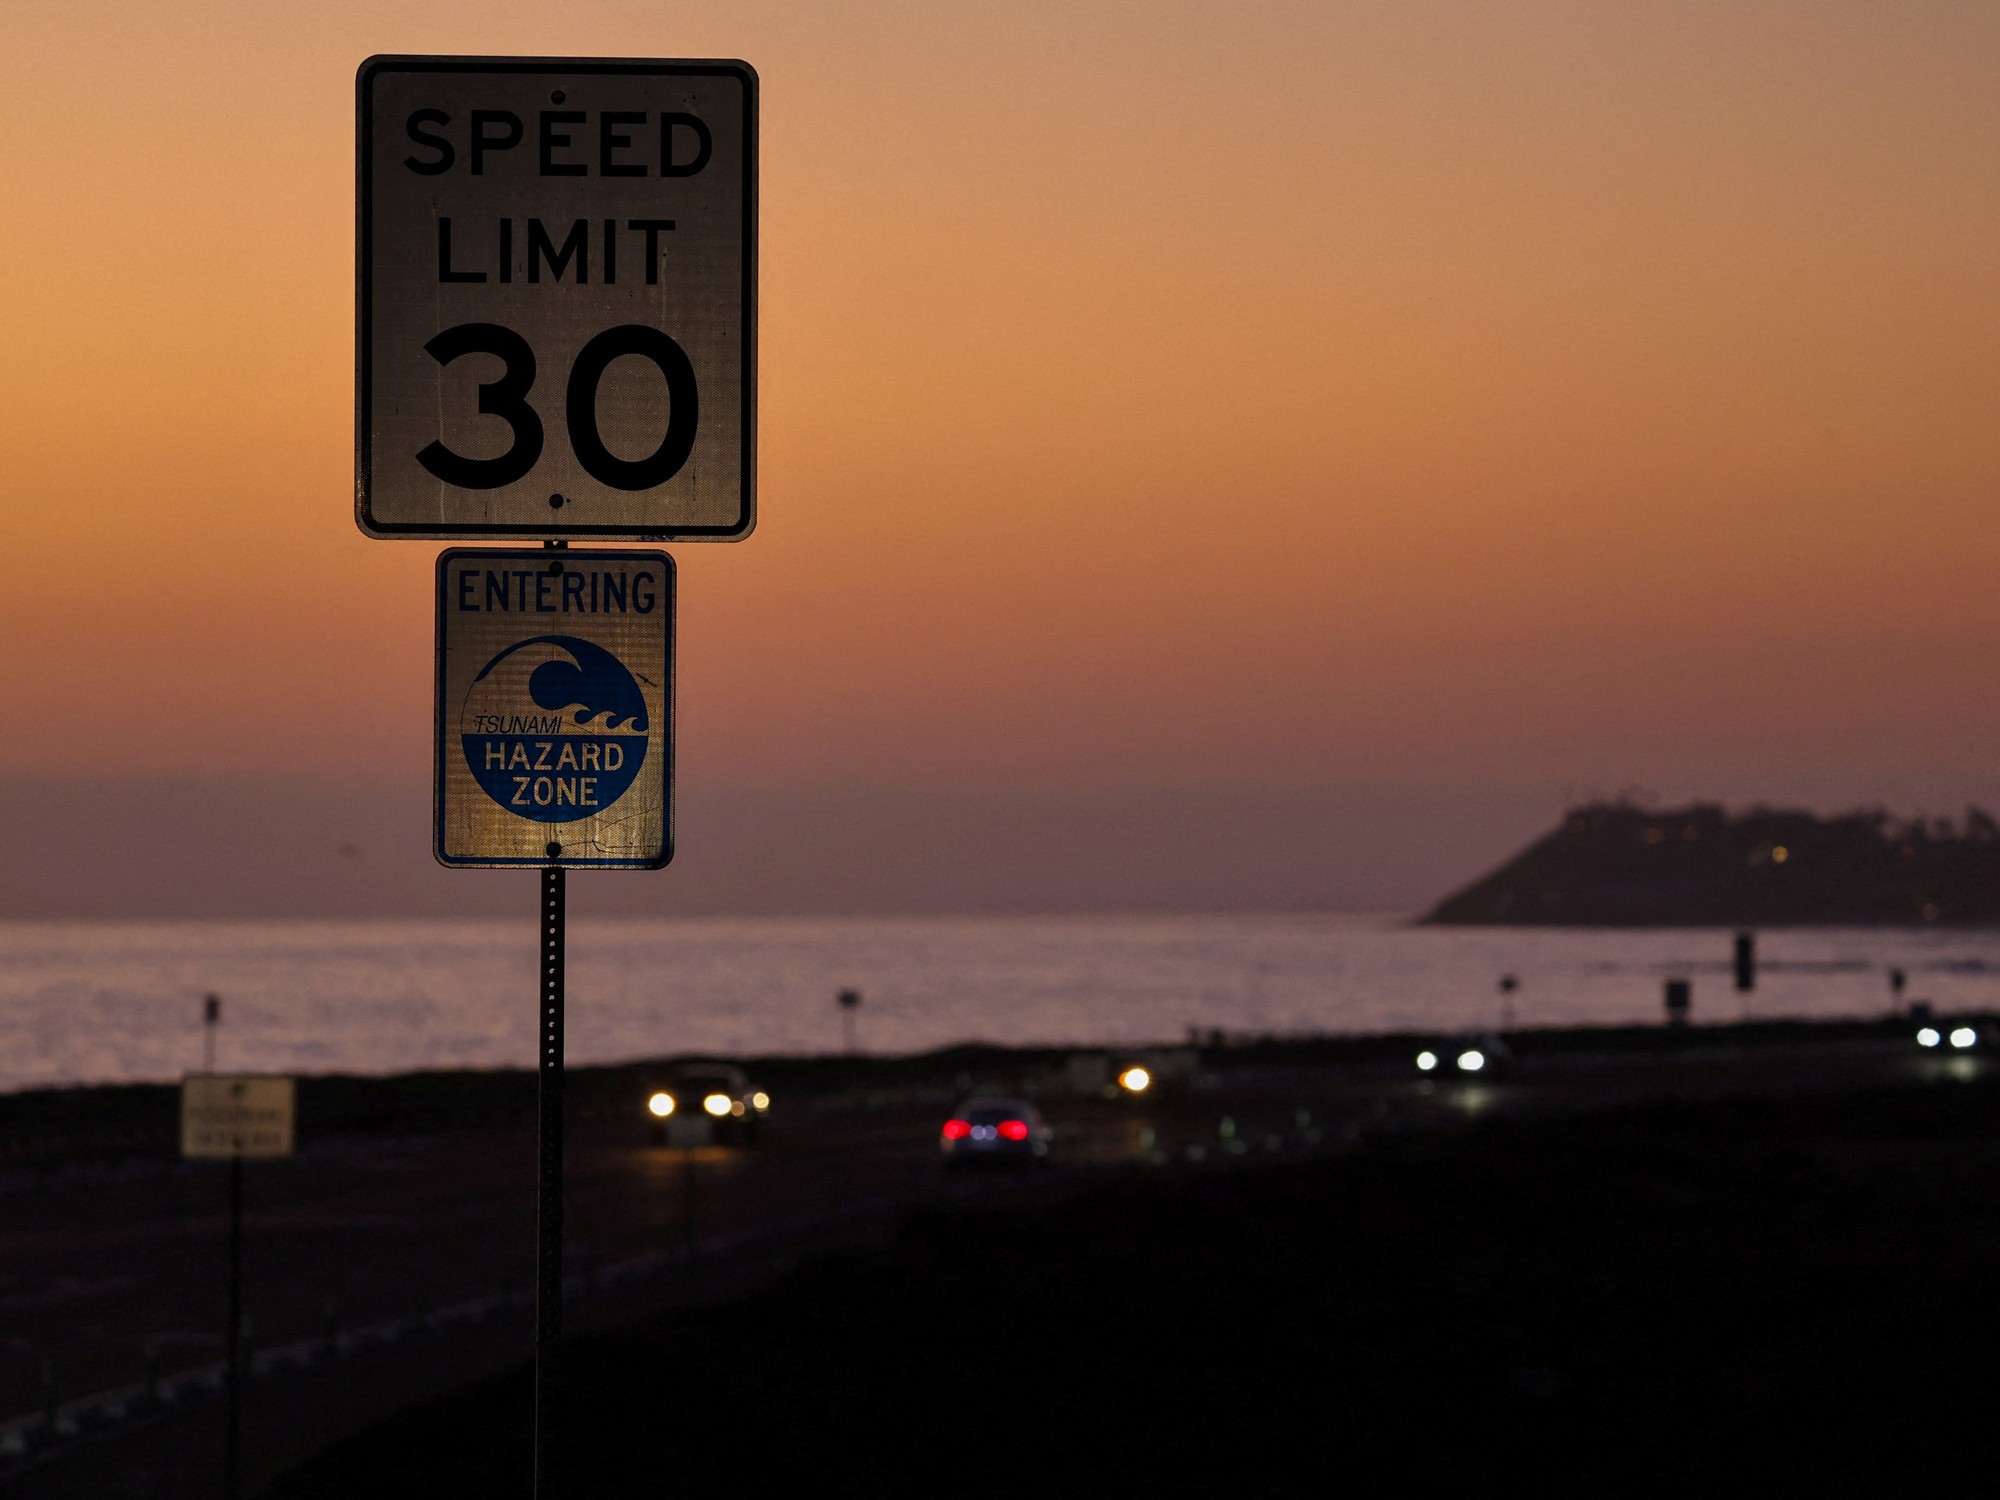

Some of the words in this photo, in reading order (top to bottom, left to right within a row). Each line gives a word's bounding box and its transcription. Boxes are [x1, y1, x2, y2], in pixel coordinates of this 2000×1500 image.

[403, 108, 712, 178] SPEED
[439, 217, 676, 284] LIMIT
[415, 323, 699, 491] 30
[458, 569, 656, 614] ENTERING
[474, 715, 563, 734] TSUNAMI
[484, 742, 625, 772] HAZARD
[510, 776, 599, 807] ZONE
